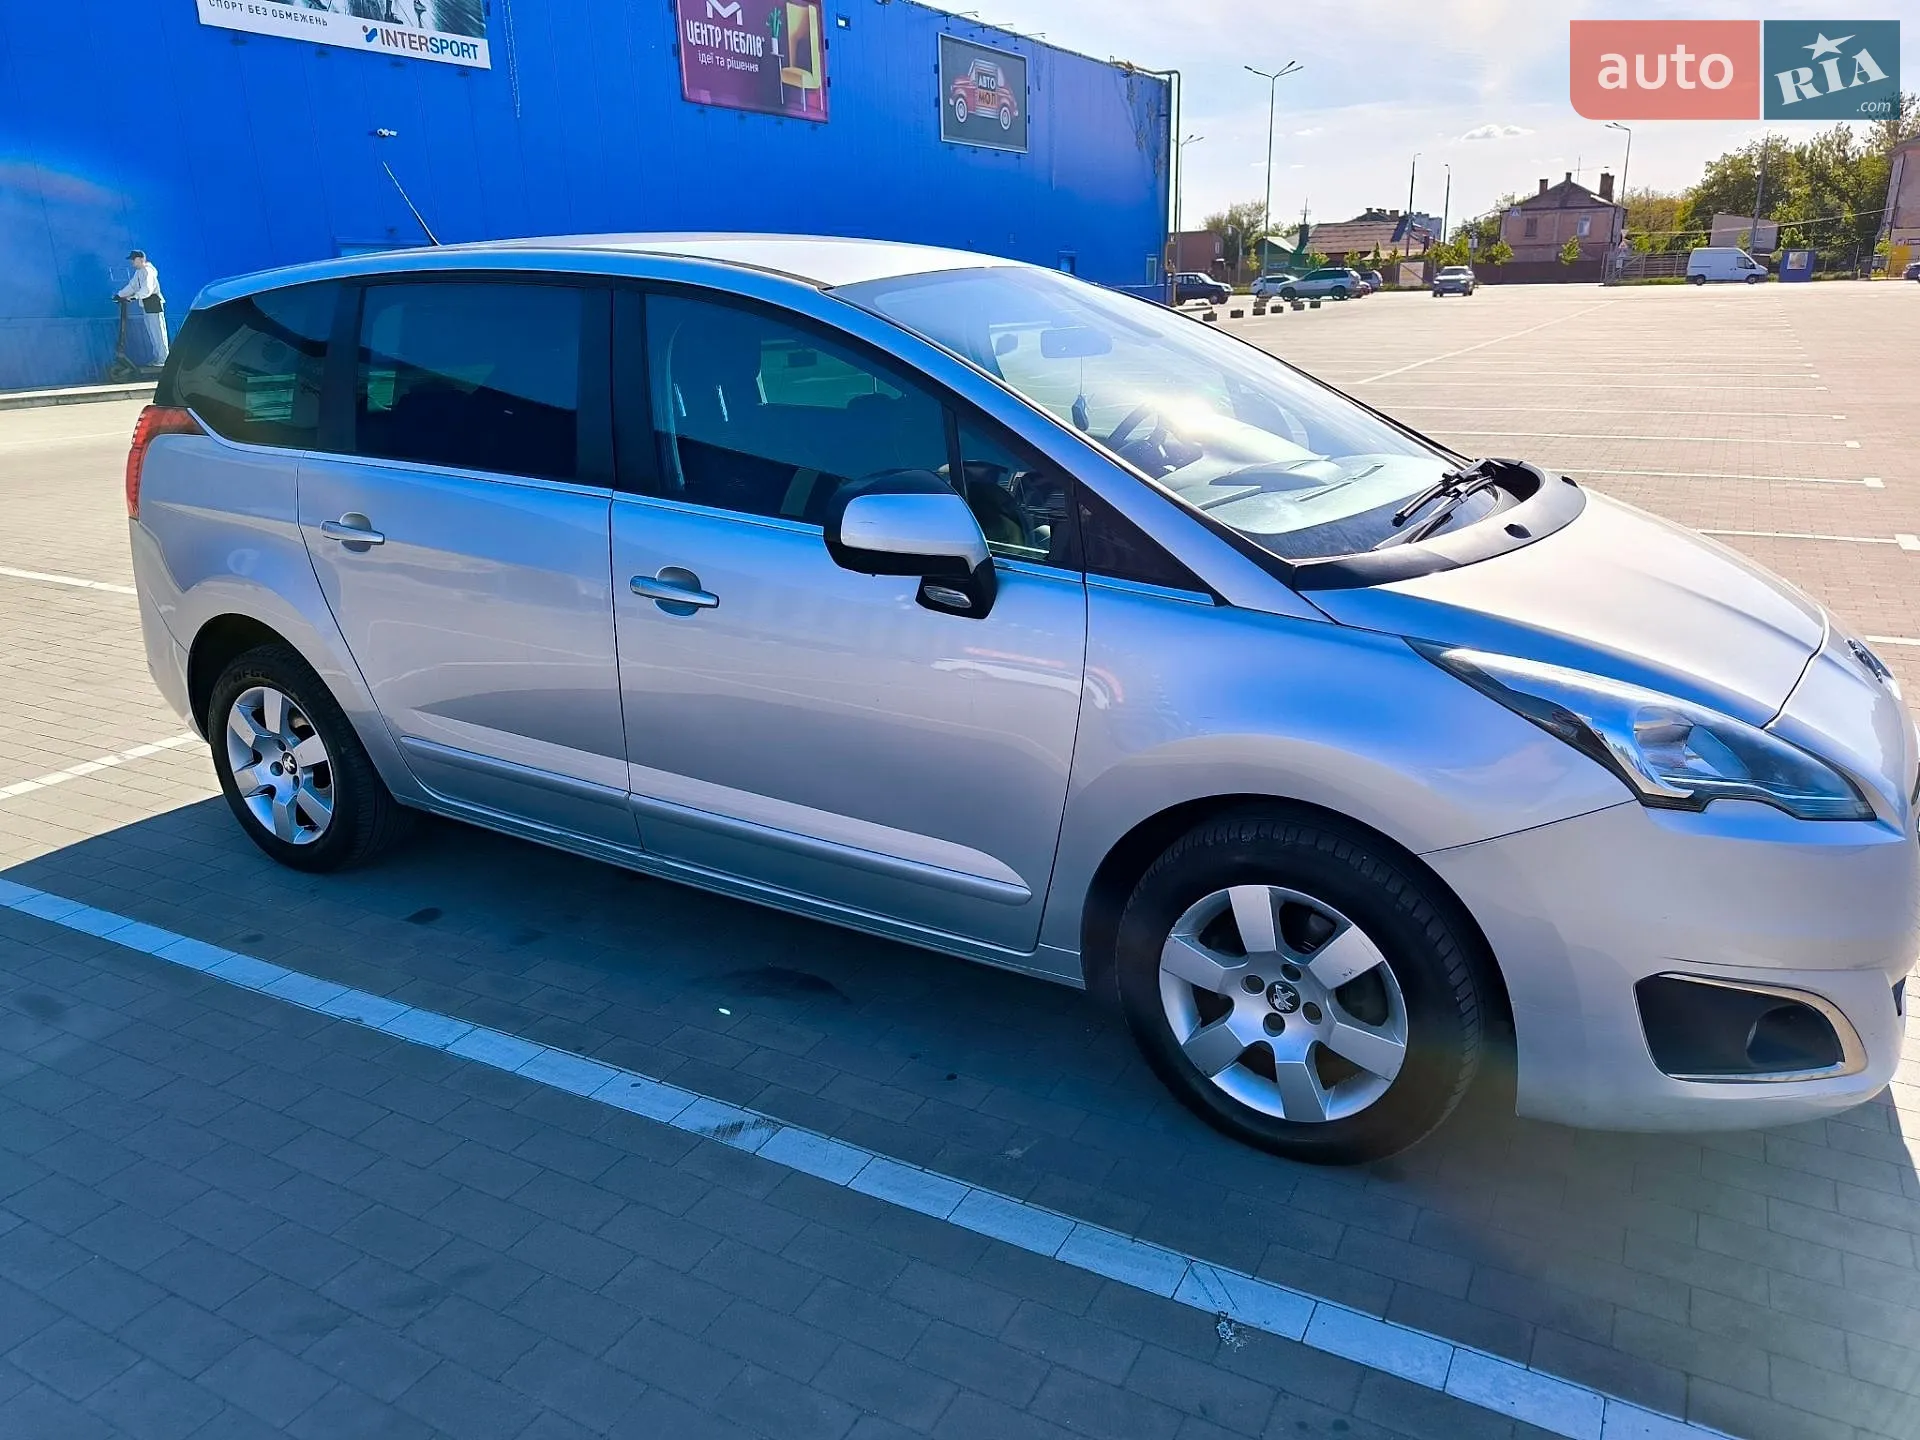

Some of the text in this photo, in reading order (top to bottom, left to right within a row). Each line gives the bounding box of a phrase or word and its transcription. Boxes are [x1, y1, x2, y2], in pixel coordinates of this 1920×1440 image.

[248, 5, 268, 16] БЕЗ
[271, 9, 328, 26] ОБМЕЖЕНЬ
[380, 28, 479, 60] INTERSPORT
[686, 20, 721, 48] ЦЕНТР
[715, 55, 725, 67] та
[726, 57, 759, 72] рішення
